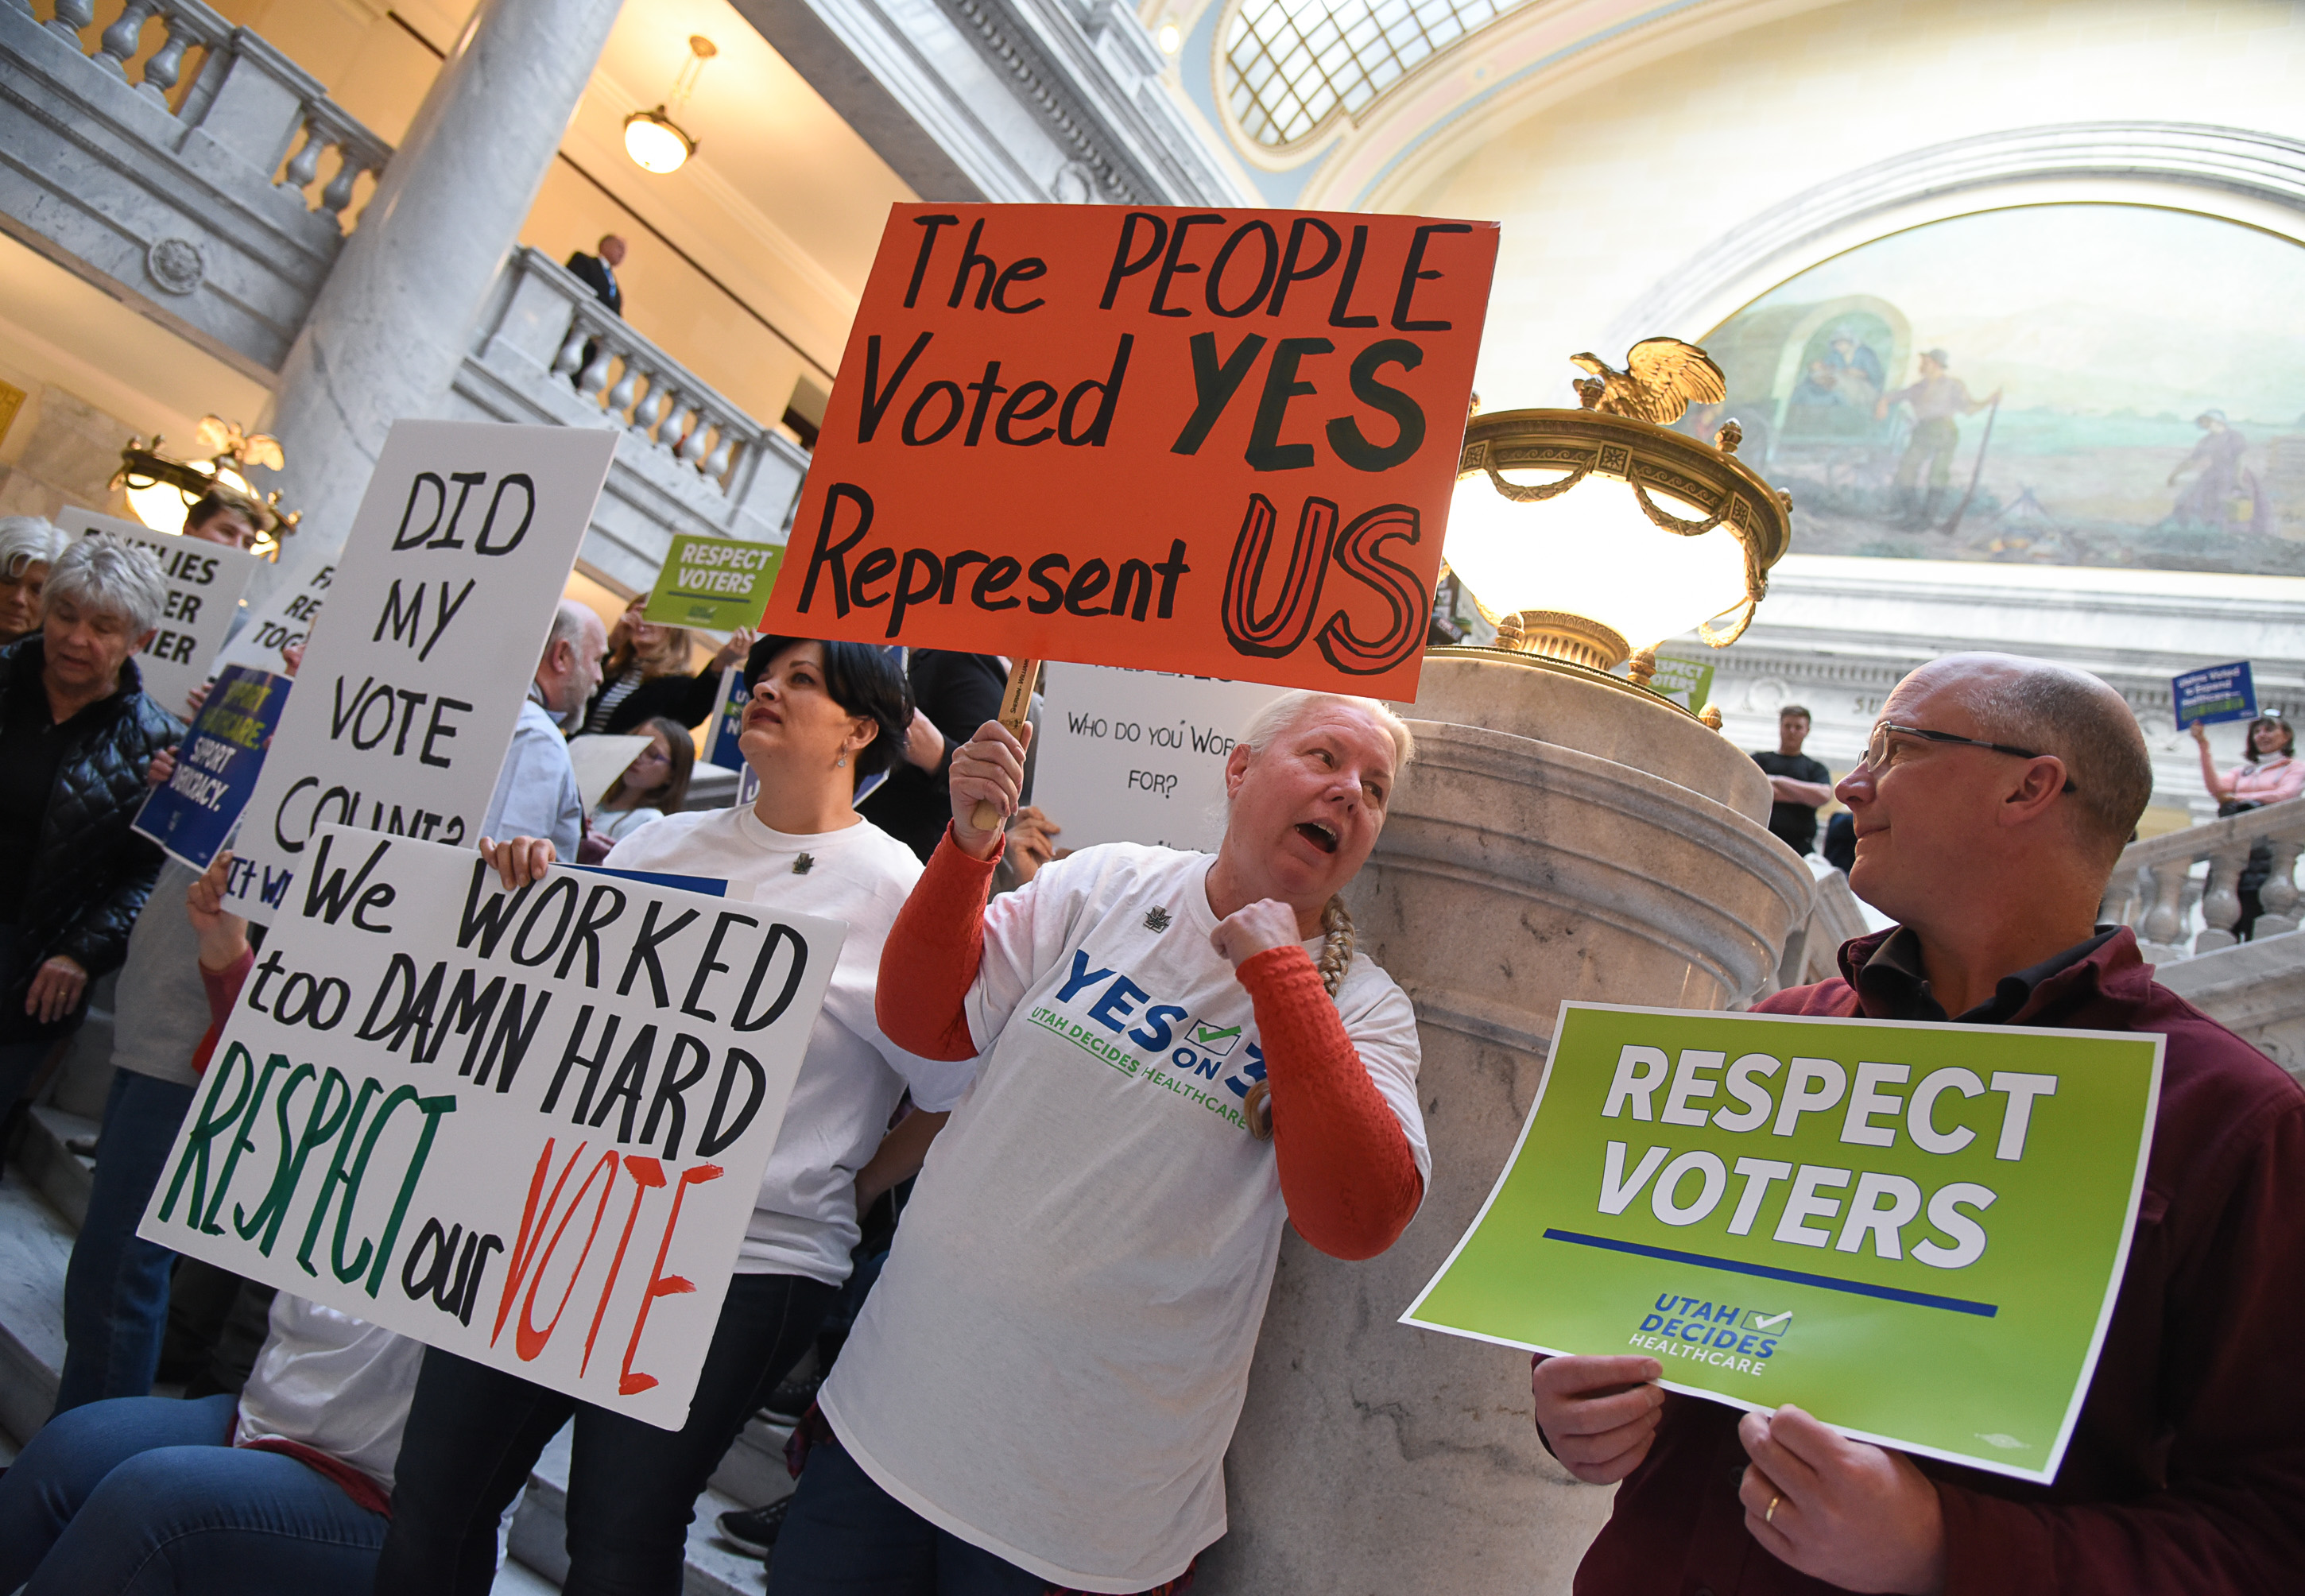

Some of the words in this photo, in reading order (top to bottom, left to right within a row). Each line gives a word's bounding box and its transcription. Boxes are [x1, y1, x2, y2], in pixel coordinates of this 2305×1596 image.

[904, 214, 1048, 314] The
[1100, 212, 1473, 332] PEOPLE
[858, 331, 1135, 447] Voted
[1169, 331, 1428, 472] YES
[392, 471, 537, 556] DID
[680, 542, 773, 571] RESPECT
[372, 578, 477, 662] MY
[678, 567, 756, 594] VOTERS
[796, 482, 1191, 639] Represent
[1221, 492, 1428, 676] US
[331, 676, 474, 769] VOTE
[1068, 711, 1107, 738] WHO
[1114, 722, 1141, 742] DO
[1191, 726, 1237, 757] WOR
[1128, 769, 1179, 800] FOR?
[304, 835, 397, 936] We
[456, 858, 809, 1032] WORKED
[247, 951, 351, 1031] too
[354, 952, 552, 1094] DAMN
[539, 1005, 768, 1161] HARD
[1056, 949, 1189, 1052] YES
[1172, 1047, 1222, 1080] ON
[1031, 1006, 1069, 1032] UTAH
[1068, 1025, 1141, 1074] DECIDES
[1141, 1067, 1247, 1130] HEALTHCARE
[1601, 1044, 2059, 1162] RESPECT
[158, 1041, 458, 1300] RESPECT
[401, 1216, 505, 1328] our
[490, 1136, 726, 1396] VOTE
[1596, 1140, 1999, 1269] VOTERS
[1629, 1333, 1766, 1376] HEALTHCARE
[1639, 1313, 1778, 1358] DECIDES
[1654, 1292, 1741, 1326] UTAH
